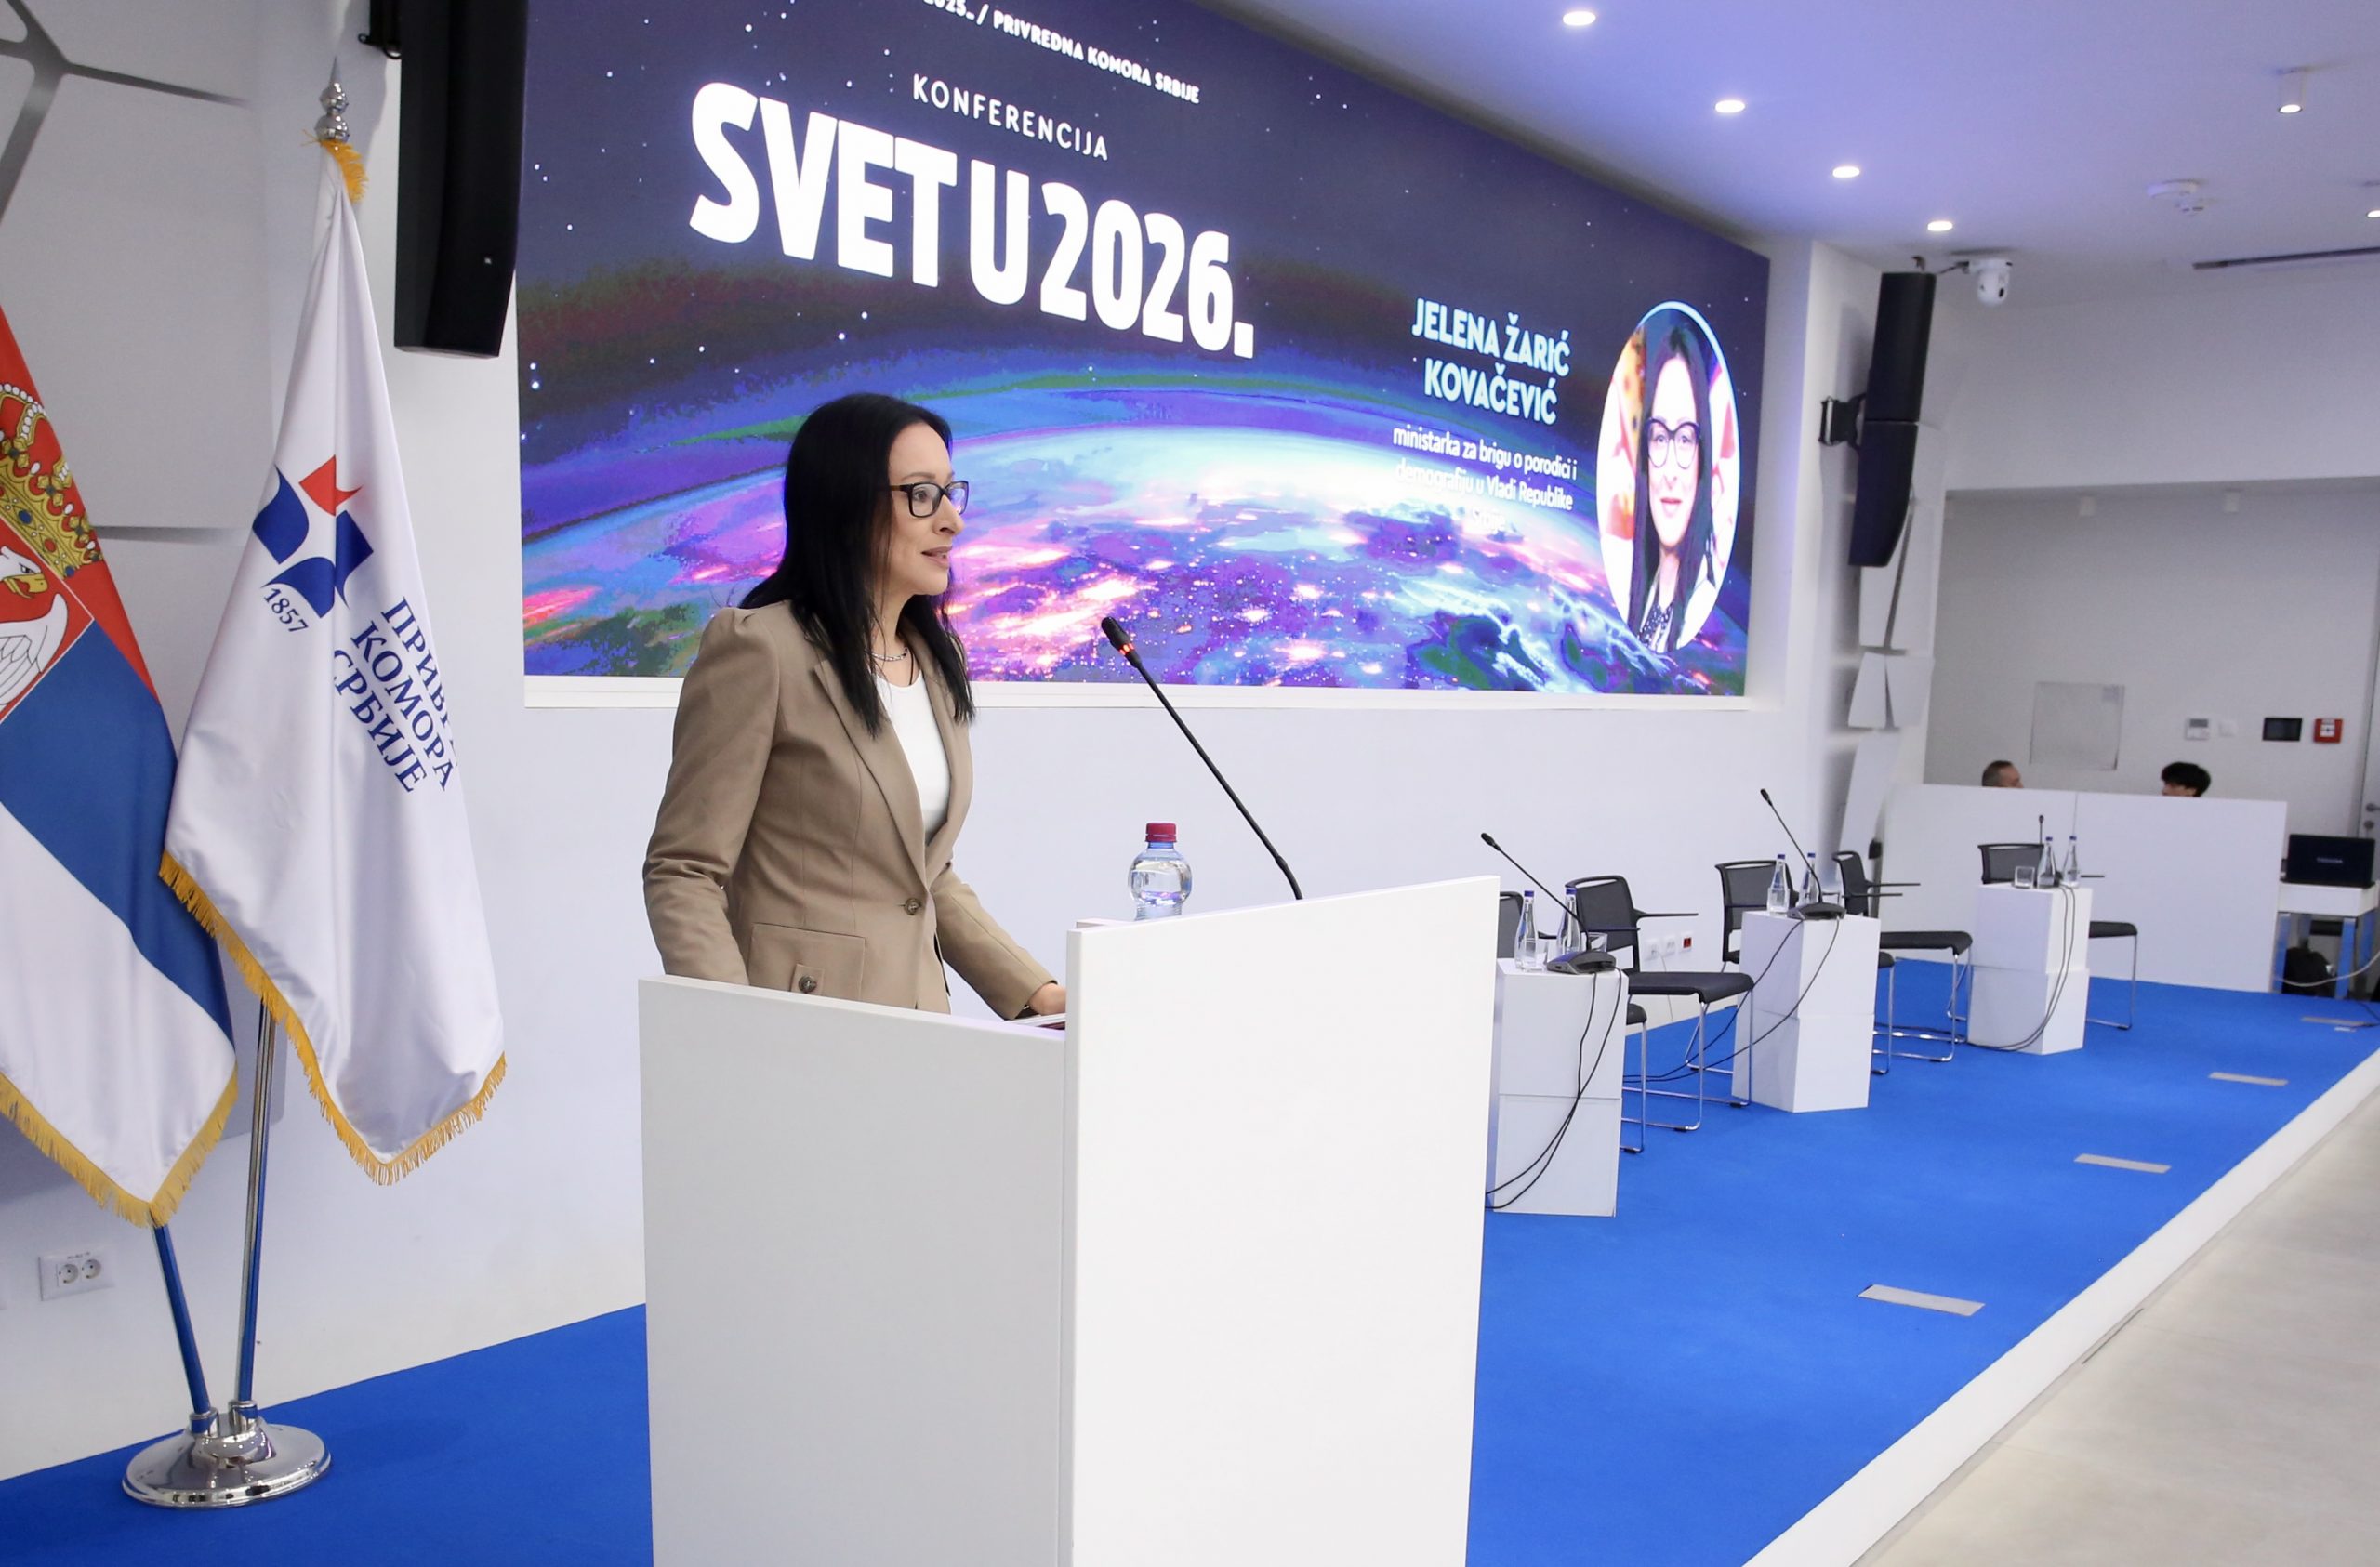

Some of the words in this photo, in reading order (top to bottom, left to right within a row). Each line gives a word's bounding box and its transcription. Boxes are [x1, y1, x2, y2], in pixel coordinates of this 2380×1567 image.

[993, 10, 1084, 61] PRIVREDNA
[1087, 46, 1152, 86] KOMORA
[1155, 72, 1200, 104] SRBIJE
[912, 73, 1109, 161] KONFERENCIJA
[690, 82, 958, 288] SVET
[970, 159, 1030, 305] U
[1040, 181, 1254, 360] 2026.
[1411, 297, 1500, 359] JELENA
[1503, 312, 1571, 377] ŽARIĆ
[1424, 358, 1558, 425] KOVAČEVIĆ
[1393, 424, 1461, 457] ministarka
[1462, 441, 1477, 461] za
[1479, 438, 1511, 470] brigu
[1514, 453, 1523, 468] o
[1524, 454, 1571, 480] porodici
[1572, 459, 1578, 481] i
[1395, 457, 1474, 494] demografiju
[1475, 478, 1484, 494] u
[1487, 475, 1516, 501] Vladi
[1518, 481, 1573, 510] Republike
[264, 587, 308, 634] 1857
[333, 649, 427, 792] СРБИЈЕ
[350, 620, 455, 791] КОМОРА
